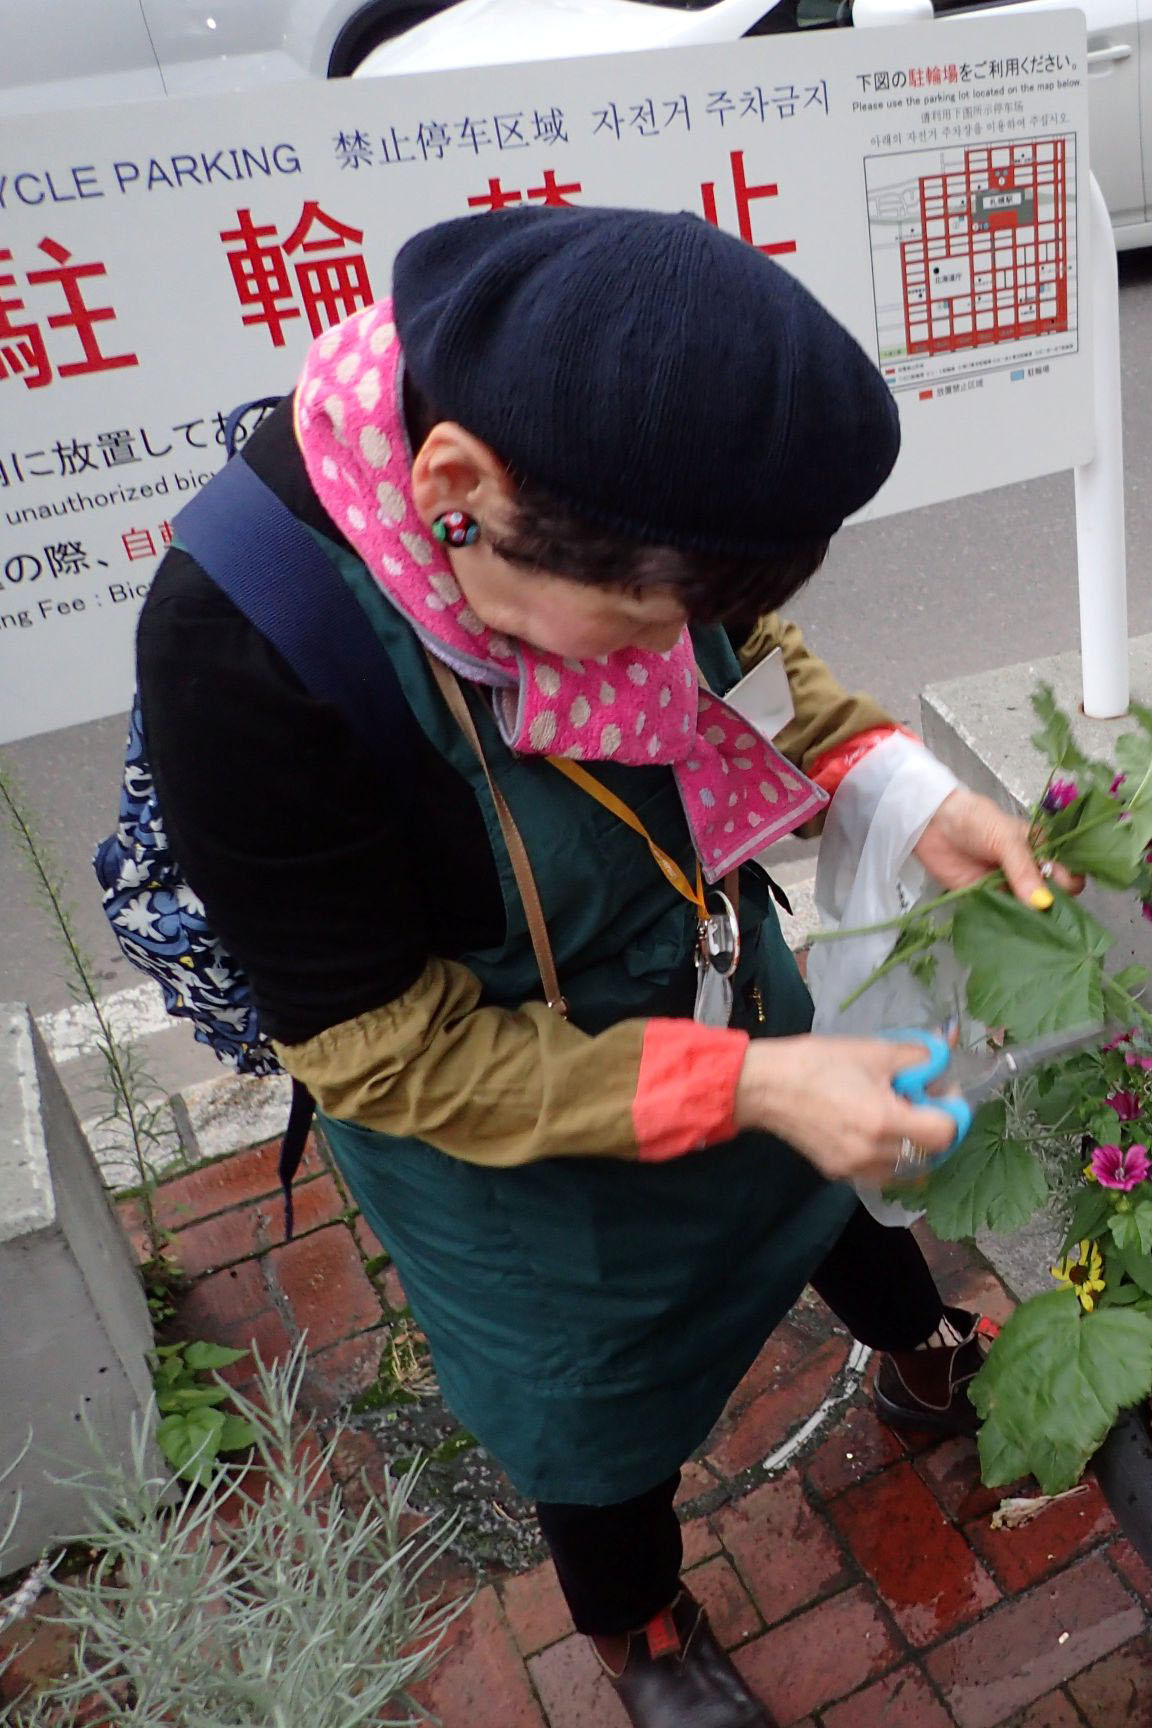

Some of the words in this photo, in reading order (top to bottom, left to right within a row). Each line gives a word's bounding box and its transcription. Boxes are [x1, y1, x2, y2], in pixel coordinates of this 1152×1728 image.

[852, 100, 884, 113] Please
[886, 99, 903, 109] use
[906, 95, 921, 106] the
[923, 91, 956, 106] parking
[958, 89, 970, 101] lot
[972, 85, 1005, 99] located
[1007, 86, 1018, 95] on
[1020, 82, 1035, 93] the
[1037, 82, 1055, 93] map
[856, 53, 1078, 93] 下図の駐輪場をご利用ください。
[592, 94, 693, 141] 자전거
[704, 78, 831, 128] 주차금지
[332, 108, 570, 171] 禁止停车区域
[113, 143, 302, 195] PARKING
[6, 476, 170, 526] unauthorized
[174, 470, 215, 492] bic
[0, 610, 33, 629] ng
[38, 598, 86, 619] Fee
[109, 581, 149, 603] Bic
